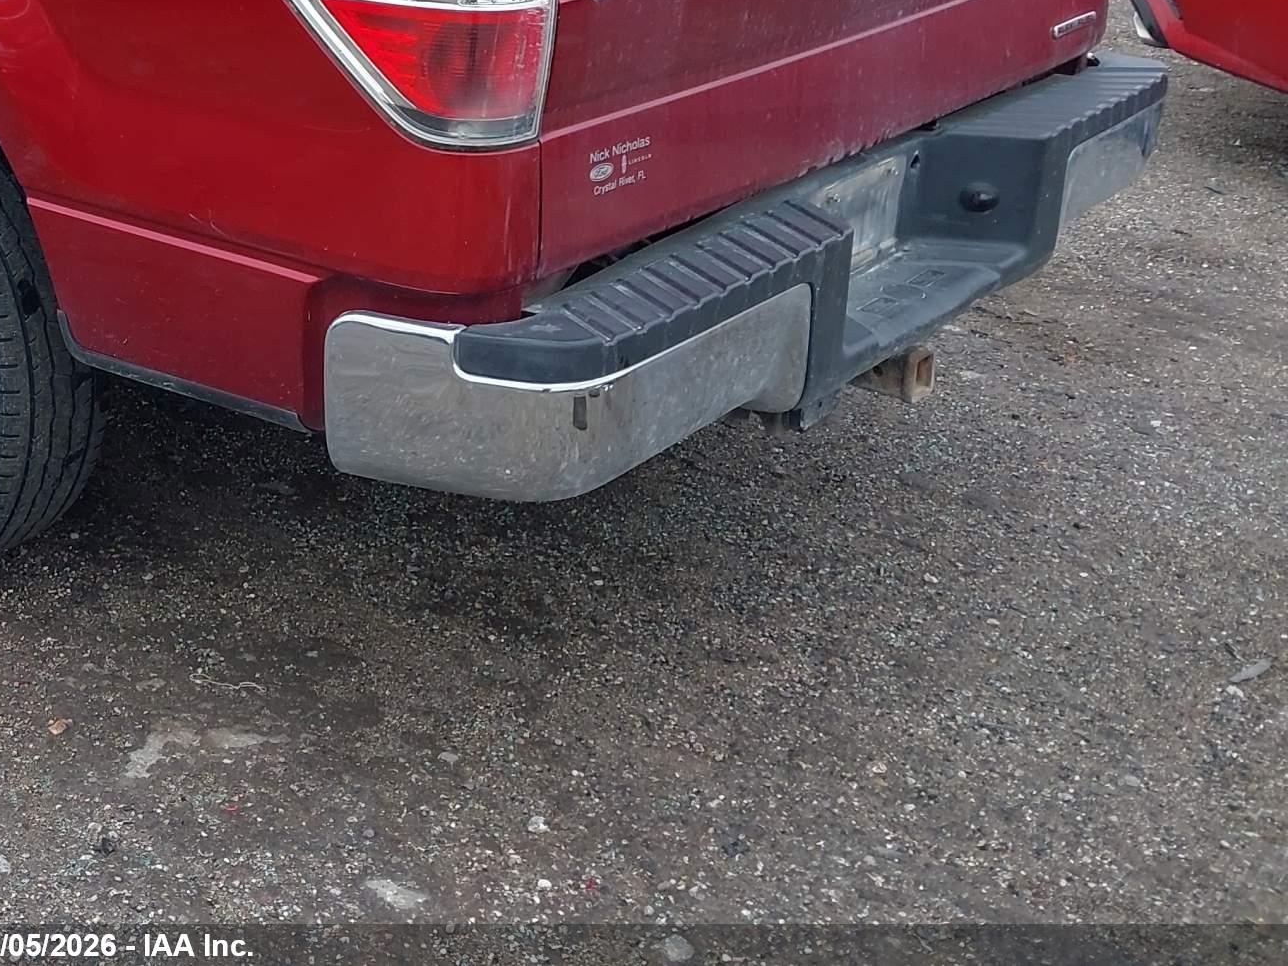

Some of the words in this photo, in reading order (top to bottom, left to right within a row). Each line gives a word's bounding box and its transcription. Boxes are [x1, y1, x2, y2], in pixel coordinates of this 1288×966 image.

[589, 147, 610, 164] Nick
[612, 136, 651, 156] Nicholas
[593, 179, 617, 196] Crystal
[637, 169, 647, 181] FL
